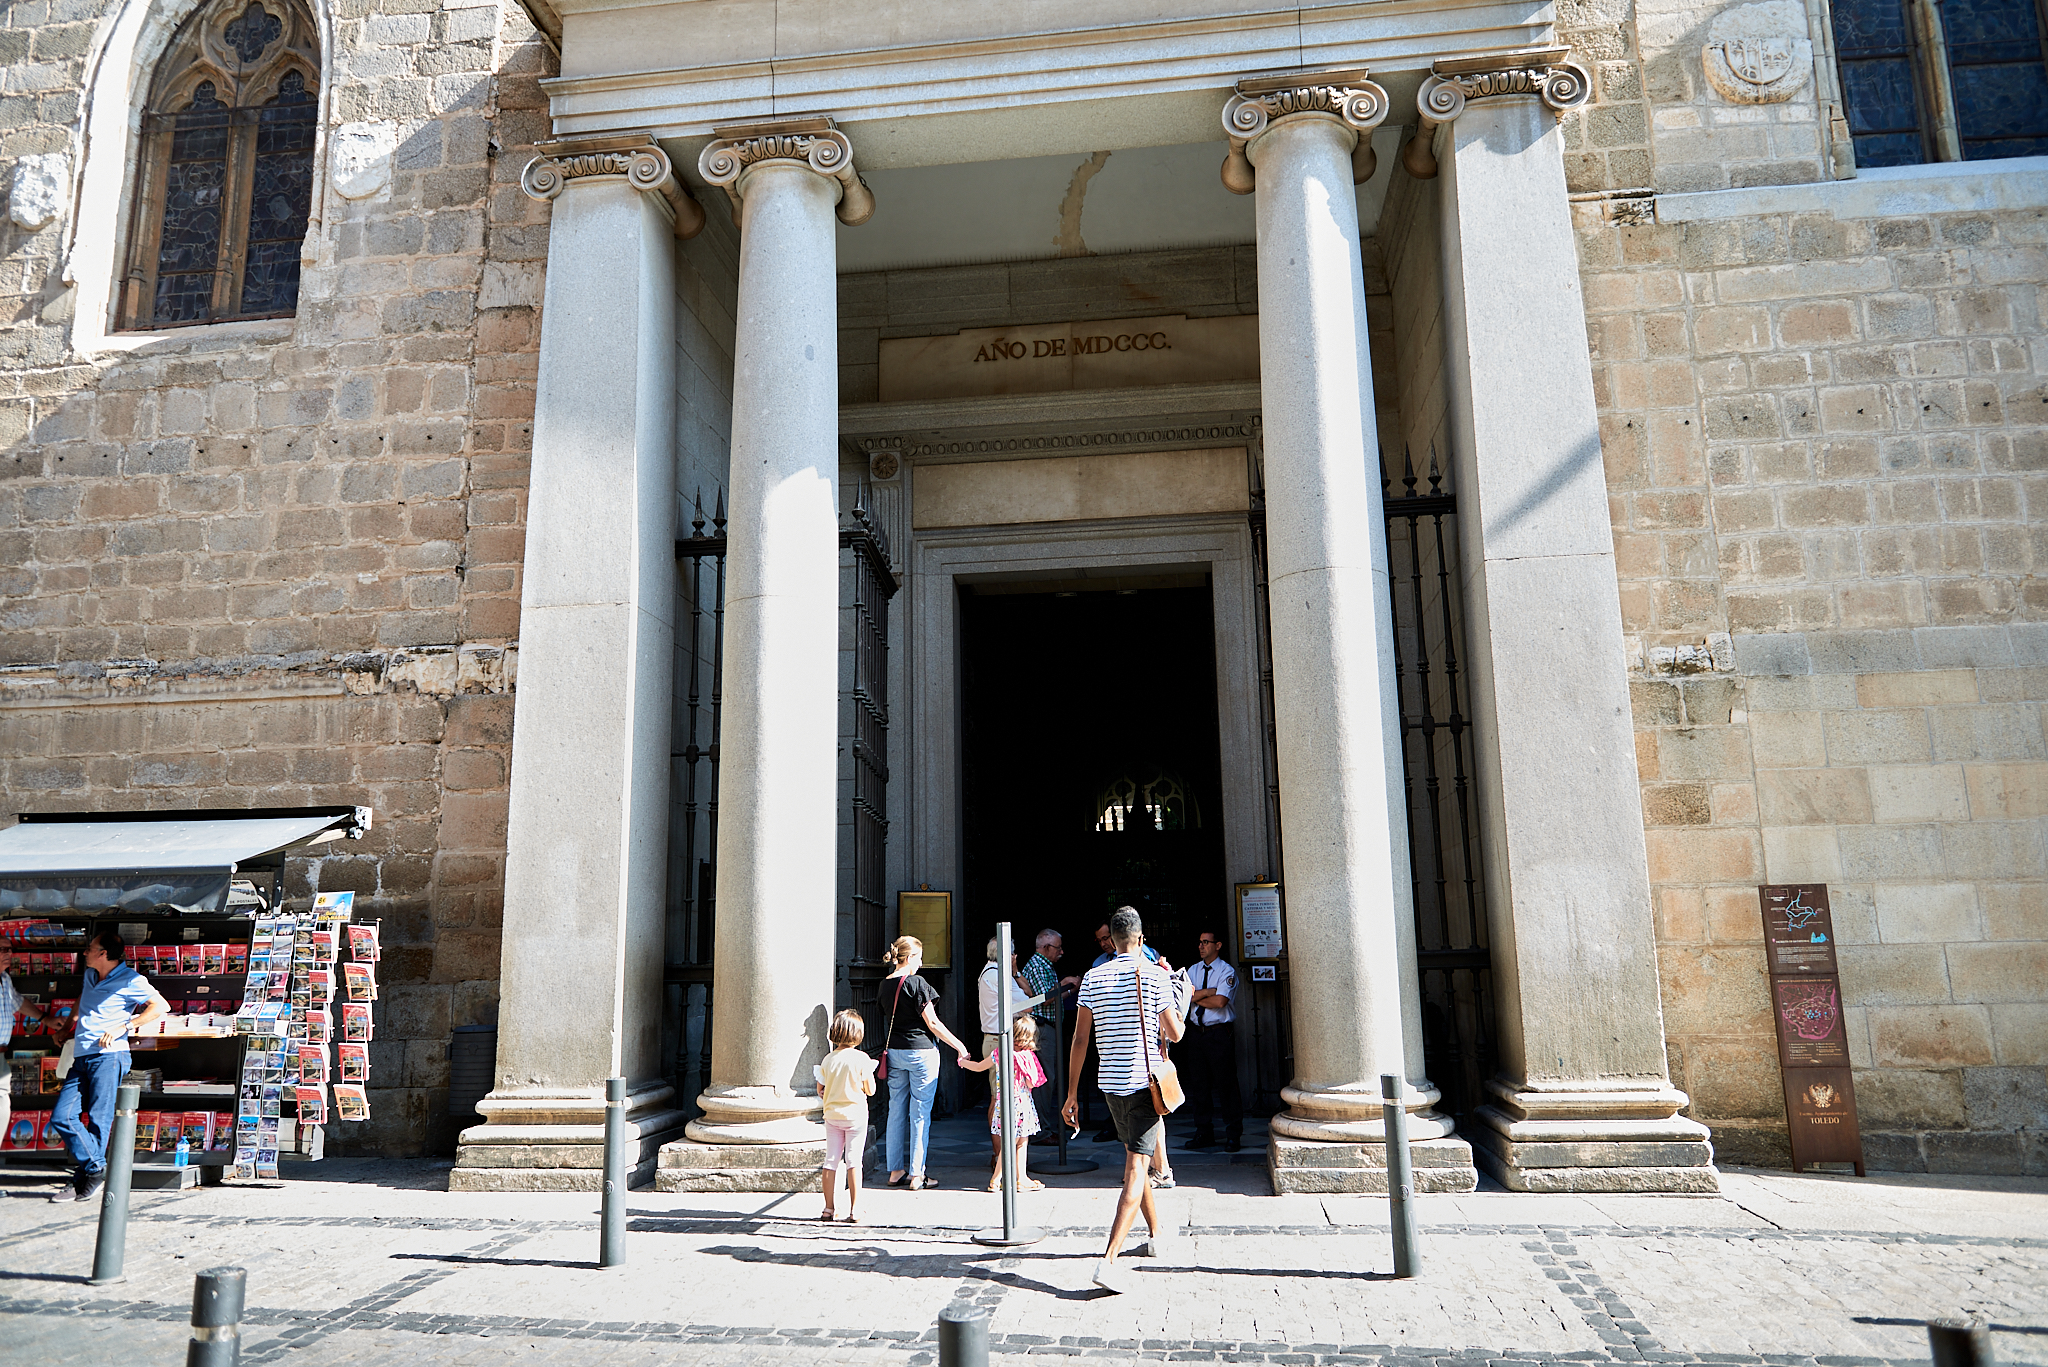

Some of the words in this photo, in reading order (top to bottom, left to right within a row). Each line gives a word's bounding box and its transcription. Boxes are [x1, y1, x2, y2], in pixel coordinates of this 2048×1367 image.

[974, 337, 1027, 362] AÑO
[1032, 338, 1067, 358] DE
[1073, 332, 1172, 356] MDCCC.
[1810, 1116, 1840, 1125] TOLEDO
